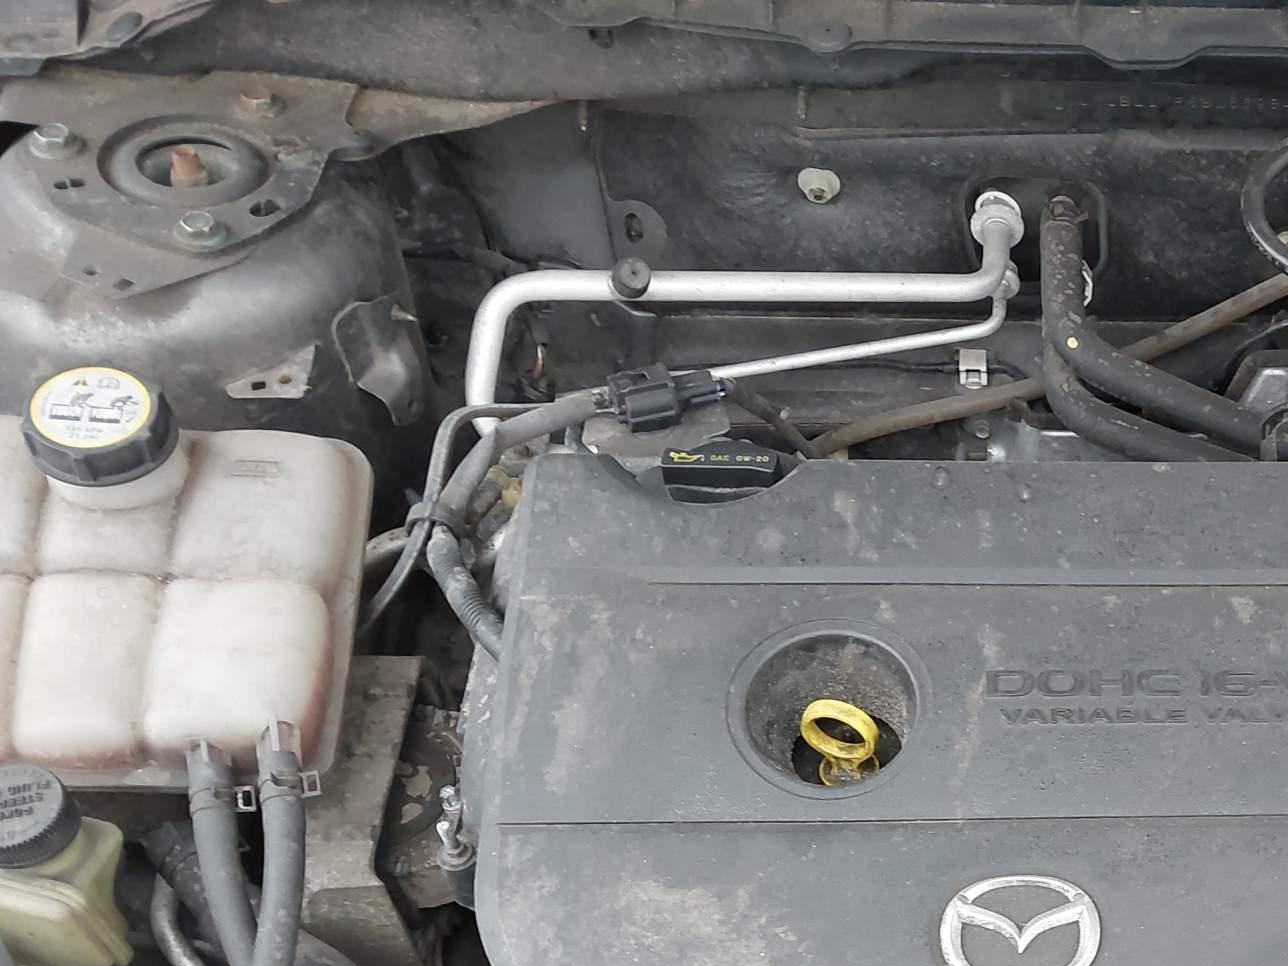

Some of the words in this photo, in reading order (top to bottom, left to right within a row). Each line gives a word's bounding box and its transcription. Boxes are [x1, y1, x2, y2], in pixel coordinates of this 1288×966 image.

[710, 454, 730, 462] SAE
[736, 455, 770, 463] 0W-20
[986, 669, 1181, 697] DOHC
[1000, 707, 1188, 725] VARIABLE
